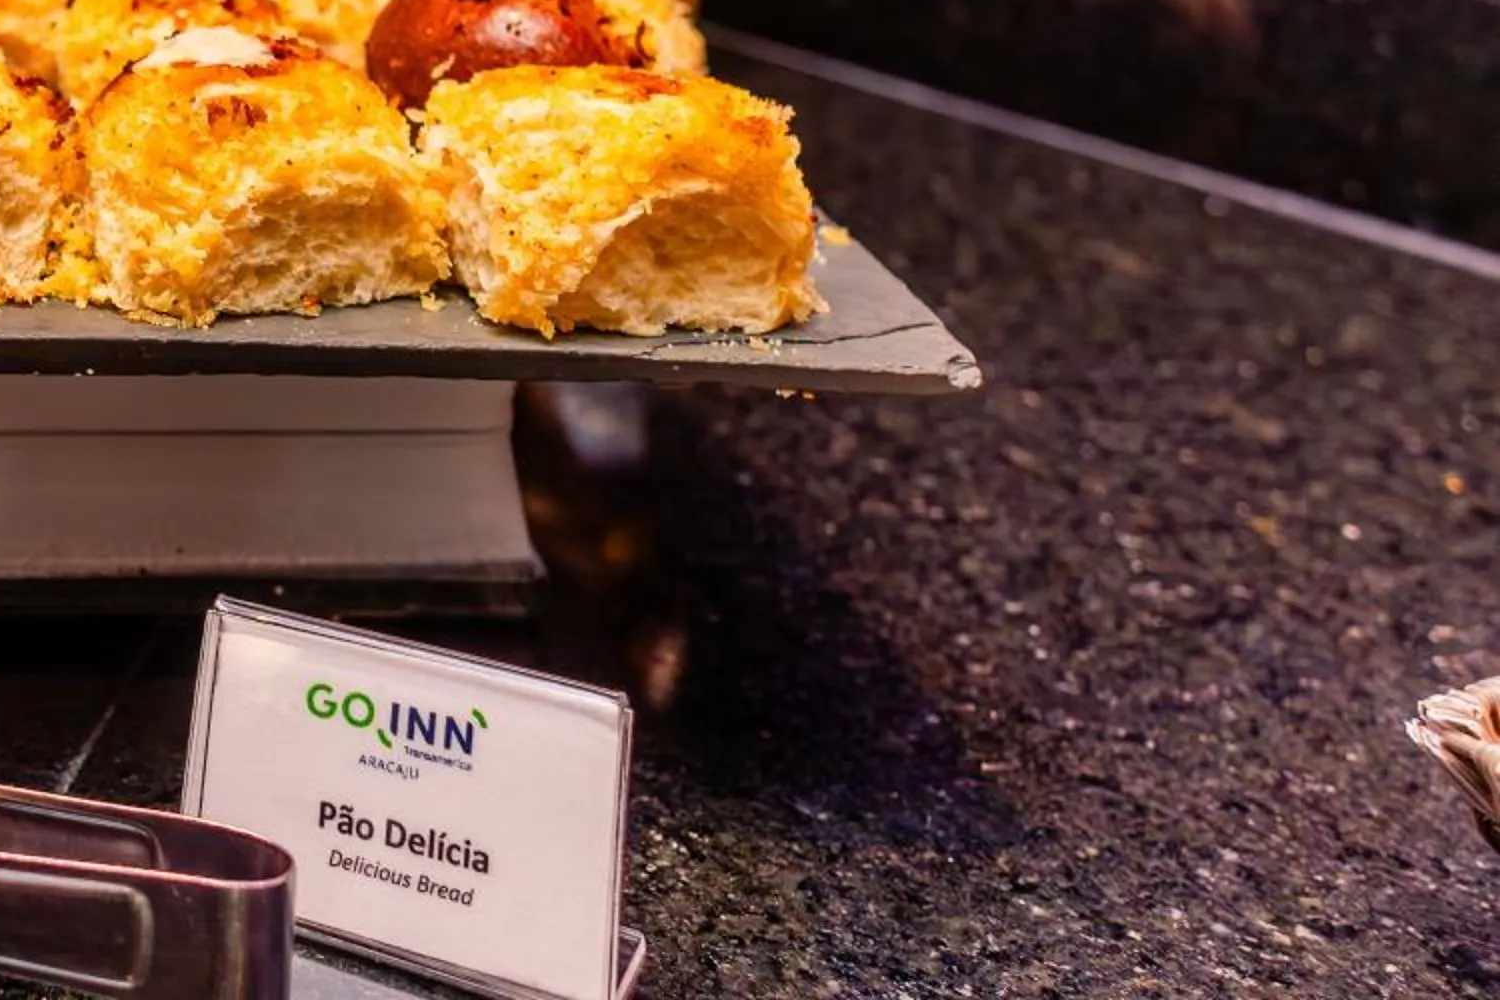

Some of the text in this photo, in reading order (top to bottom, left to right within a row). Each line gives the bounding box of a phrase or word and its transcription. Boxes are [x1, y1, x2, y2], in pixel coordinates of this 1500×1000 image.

[306, 683, 475, 755] GO INN
[358, 754, 420, 780] ARACAJU
[318, 801, 490, 874] Pão Delícia
[328, 849, 475, 906] Delicious Bread
